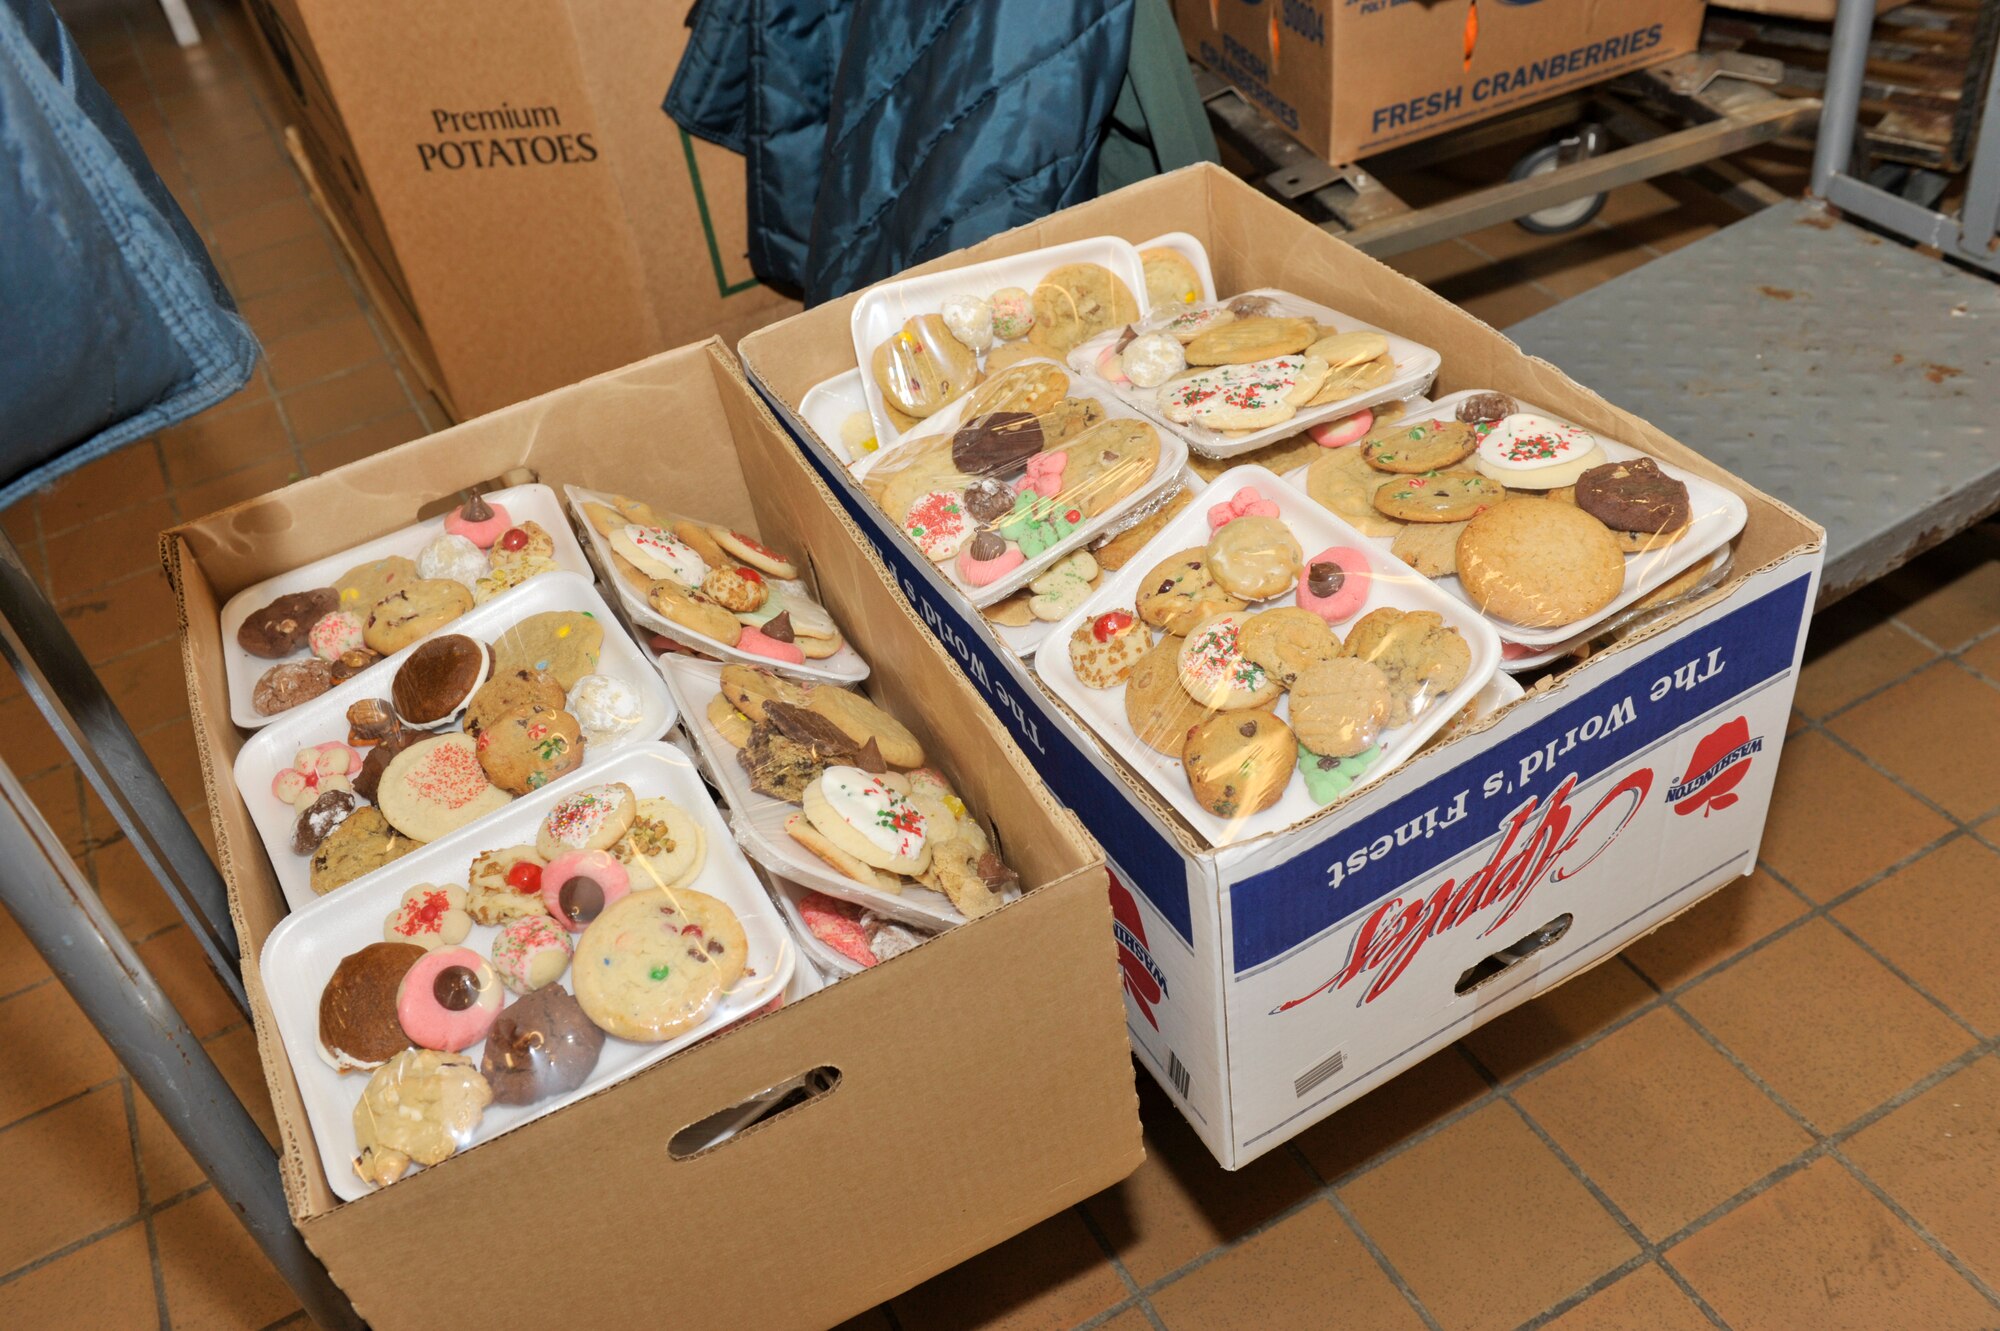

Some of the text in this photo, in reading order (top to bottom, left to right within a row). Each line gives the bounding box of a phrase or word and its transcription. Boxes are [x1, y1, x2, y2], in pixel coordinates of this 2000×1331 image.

[1222, 32, 1269, 84] FRESH
[1372, 84, 1463, 134] FRESH
[1471, 23, 1664, 102] CRANBERRIES
[417, 134, 598, 171] POTATOES
[431, 102, 561, 133] Premium
[904, 577, 1046, 756] The World's
[1328, 646, 1726, 890] The World's Finest
[1663, 738, 1763, 803] WASHINGTON
[1268, 767, 1655, 1014] Apples
